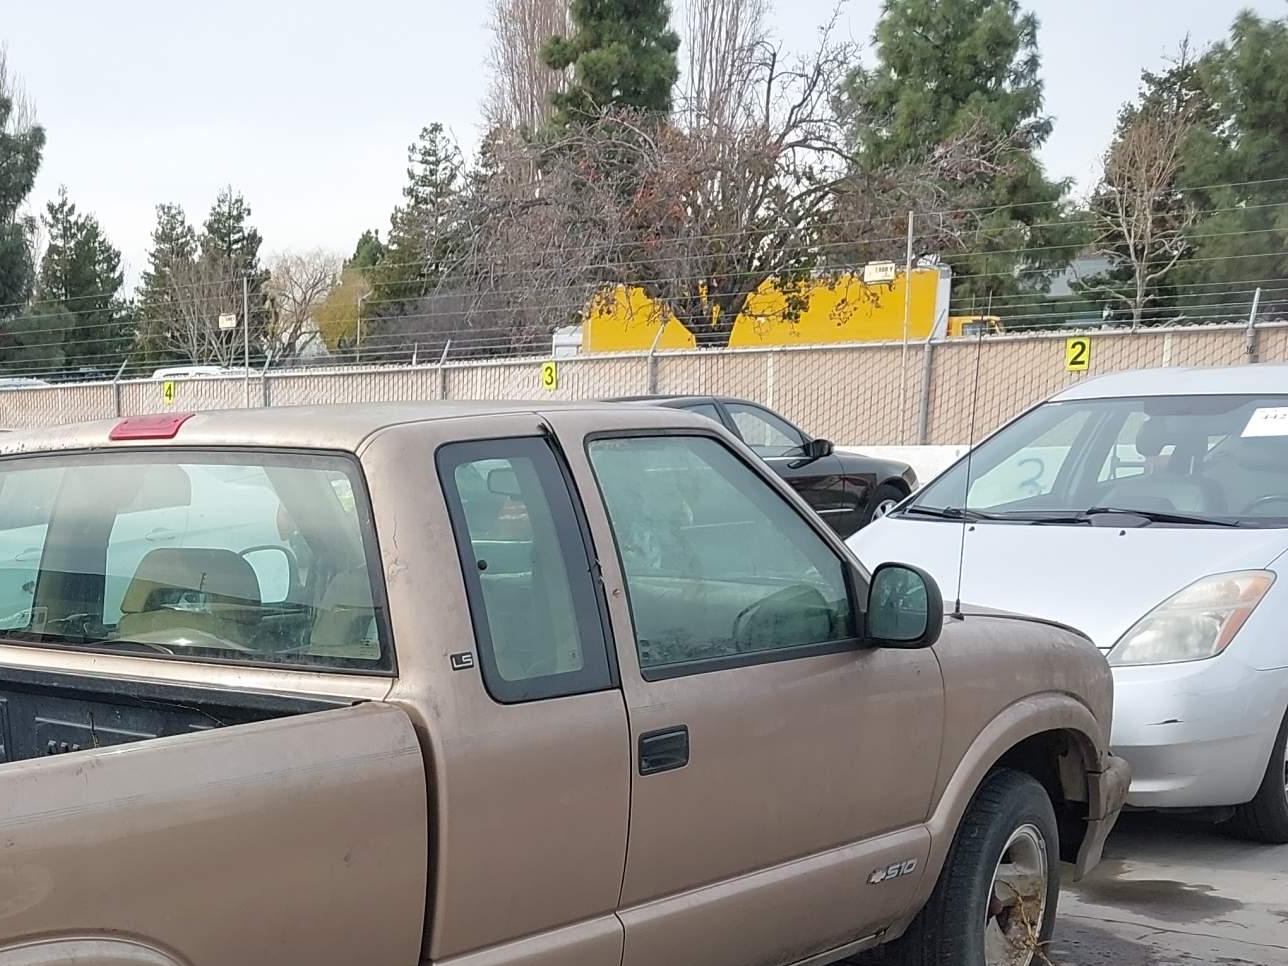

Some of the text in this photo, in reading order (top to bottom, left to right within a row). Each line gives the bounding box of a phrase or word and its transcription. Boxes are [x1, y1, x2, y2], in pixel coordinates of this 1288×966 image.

[1069, 341, 1086, 365] 2
[545, 366, 553, 385] 3
[164, 385, 172, 400] 4
[452, 654, 473, 668] LS
[885, 859, 917, 880] S10
